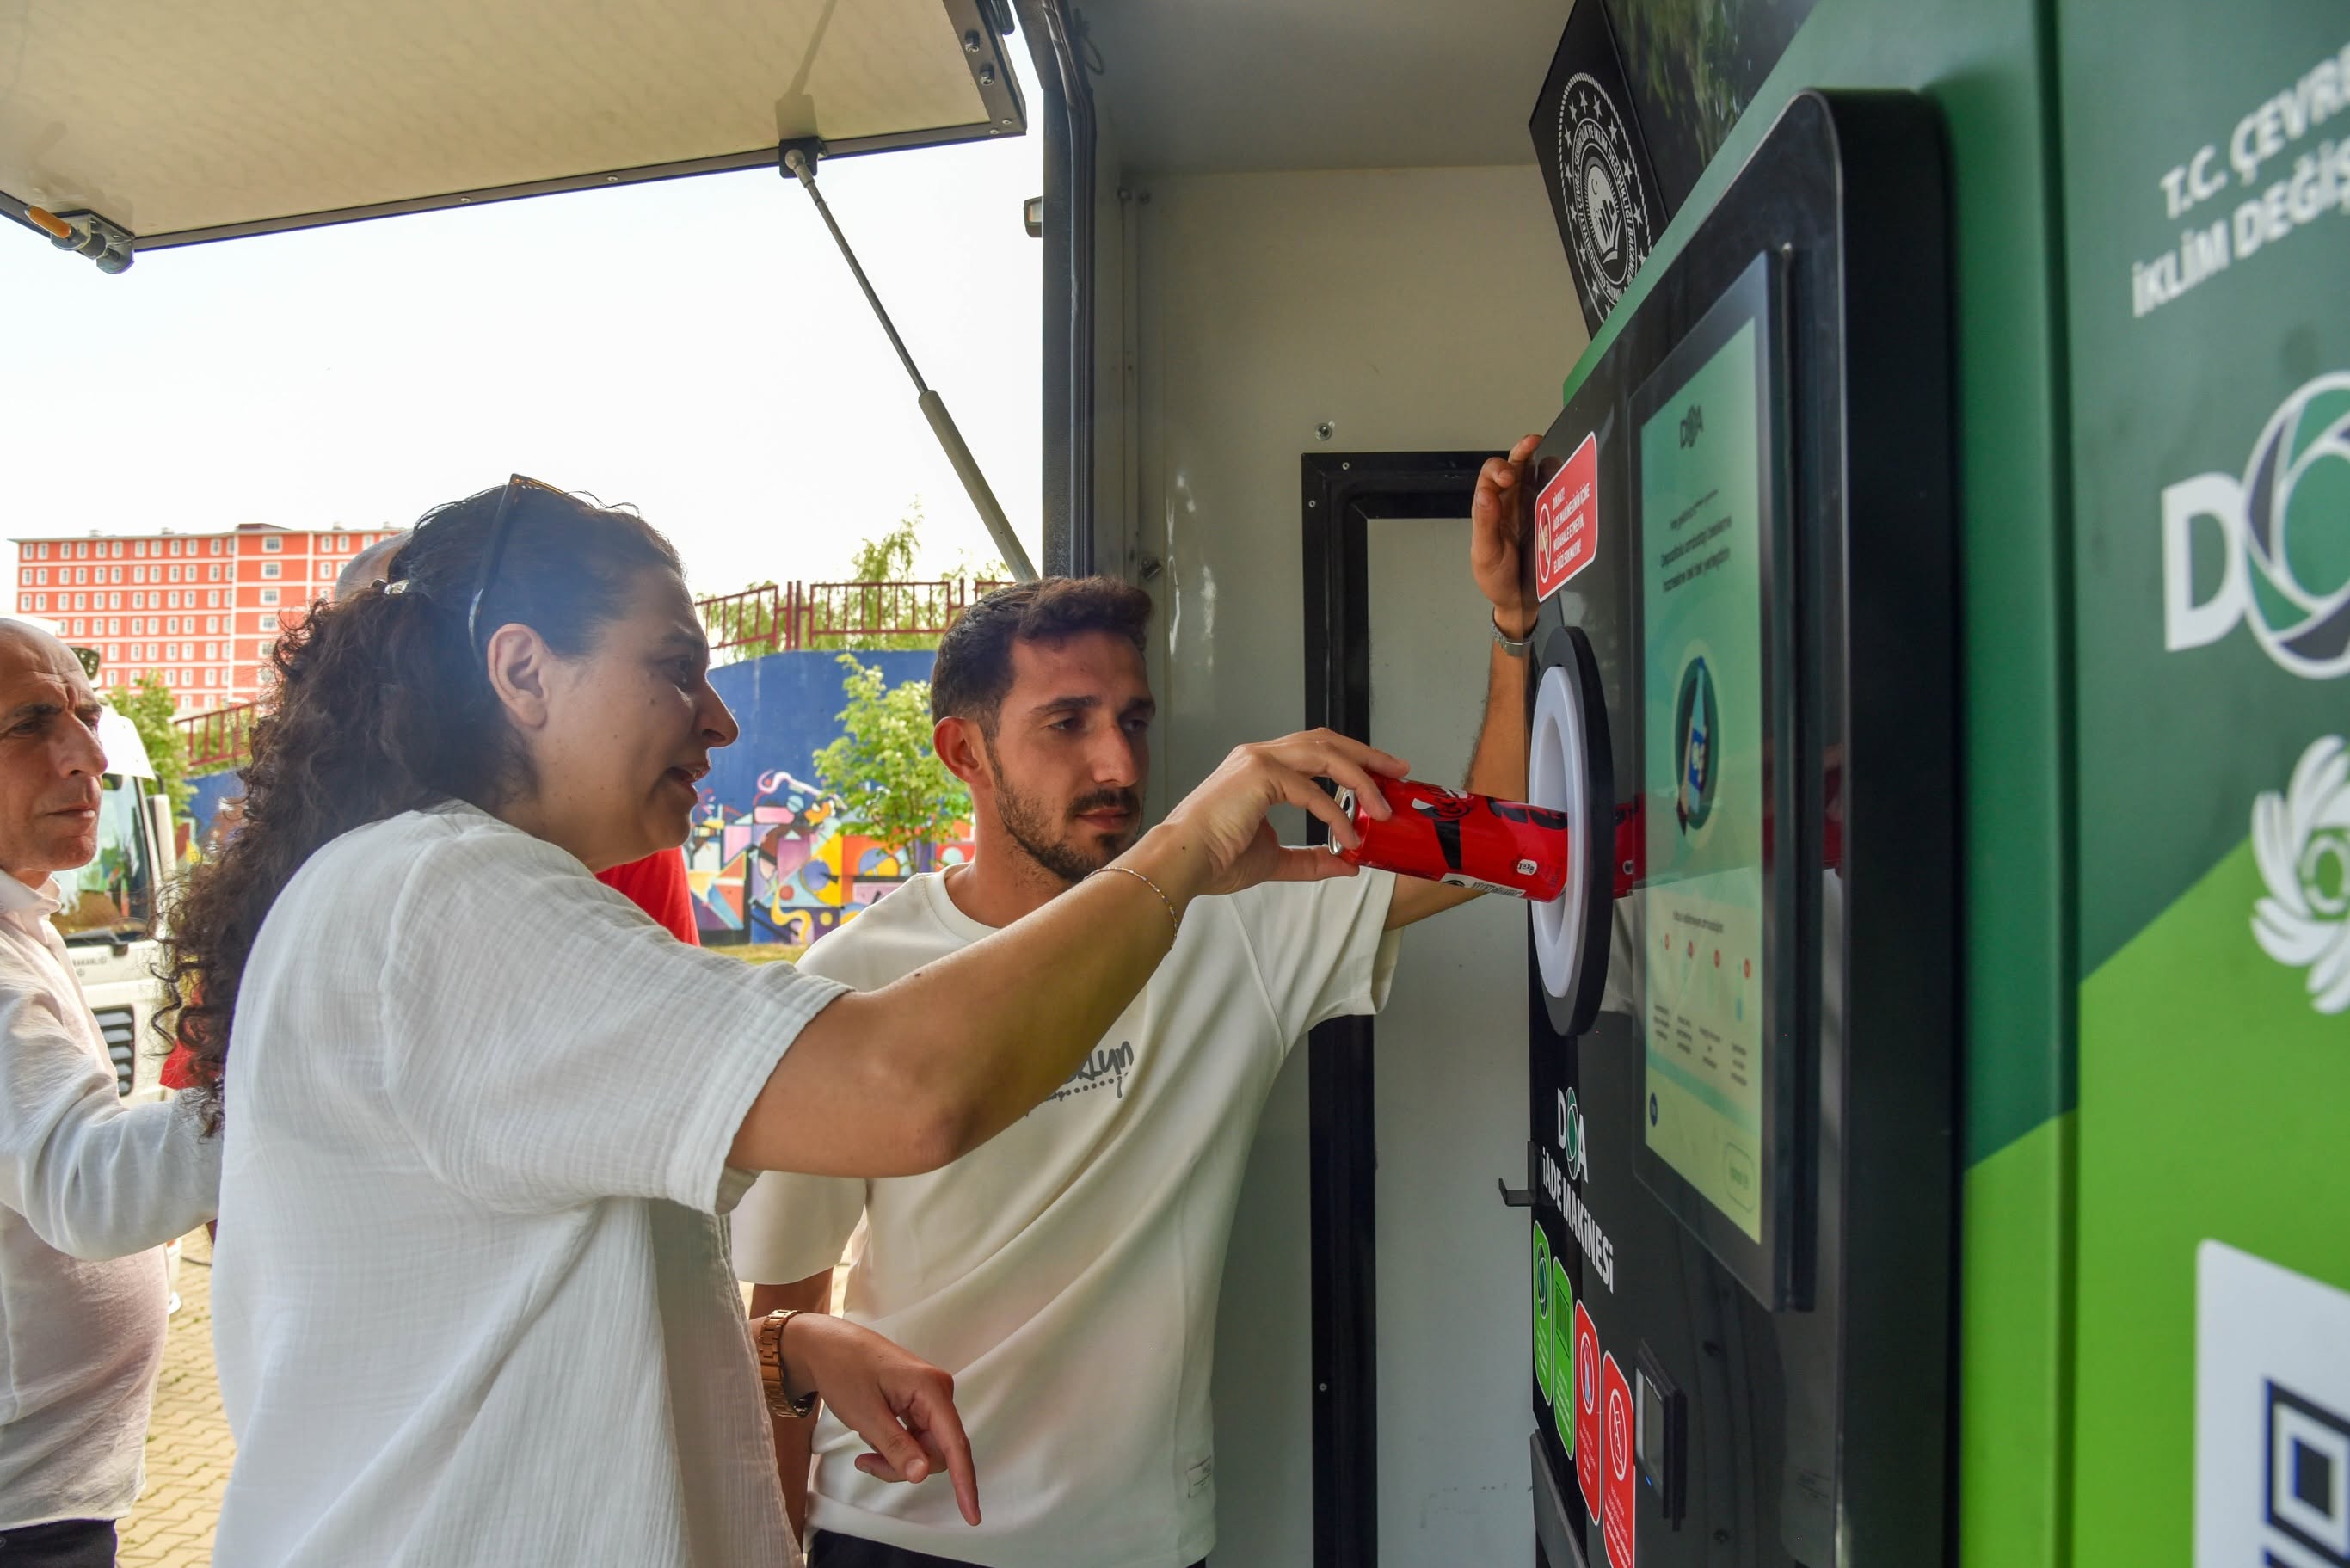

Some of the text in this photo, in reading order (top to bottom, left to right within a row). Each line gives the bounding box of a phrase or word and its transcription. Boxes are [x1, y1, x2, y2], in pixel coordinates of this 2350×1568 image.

[2132, 219, 2230, 317] İKLİM
[1557, 1086, 1589, 1184] DOA
[1542, 1146, 1614, 1294] İADE MAKİNESİ
